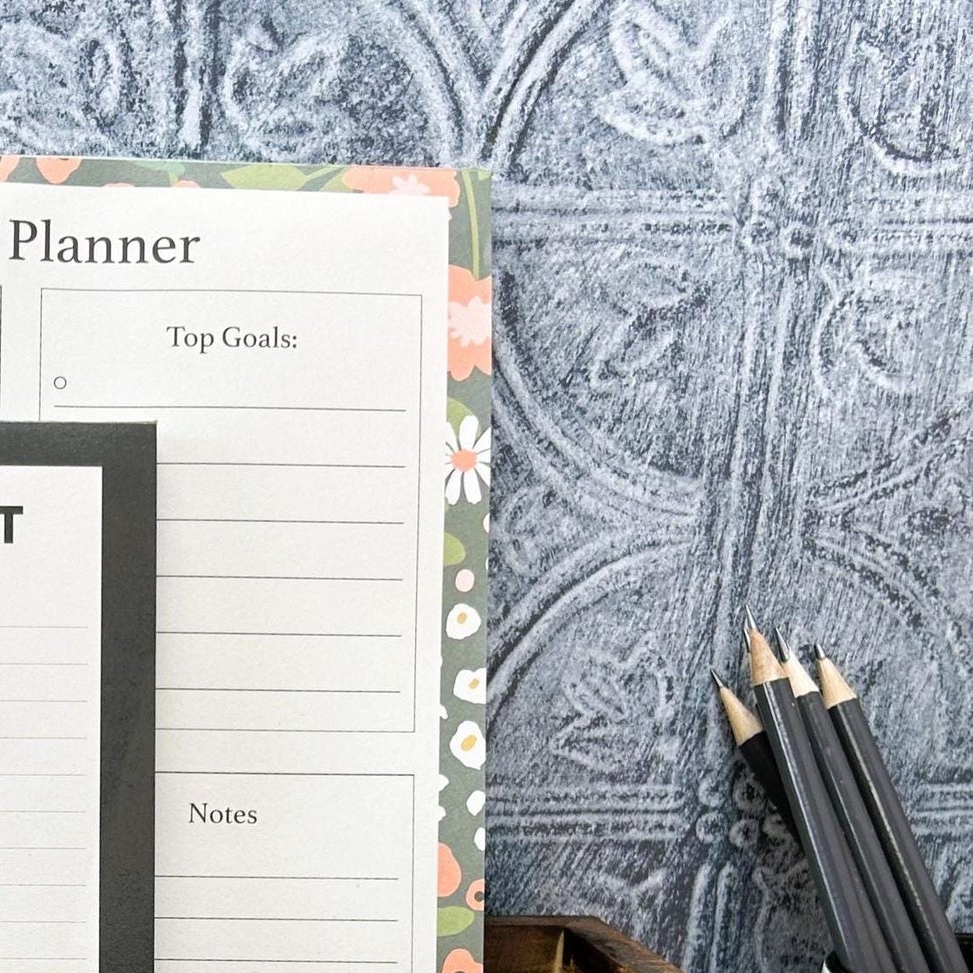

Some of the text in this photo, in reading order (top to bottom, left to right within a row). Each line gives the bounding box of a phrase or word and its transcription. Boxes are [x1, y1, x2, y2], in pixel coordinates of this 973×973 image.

[8, 216, 201, 265] Planner
[167, 325, 298, 355] Top Goals:
[189, 801, 259, 826] Notes
